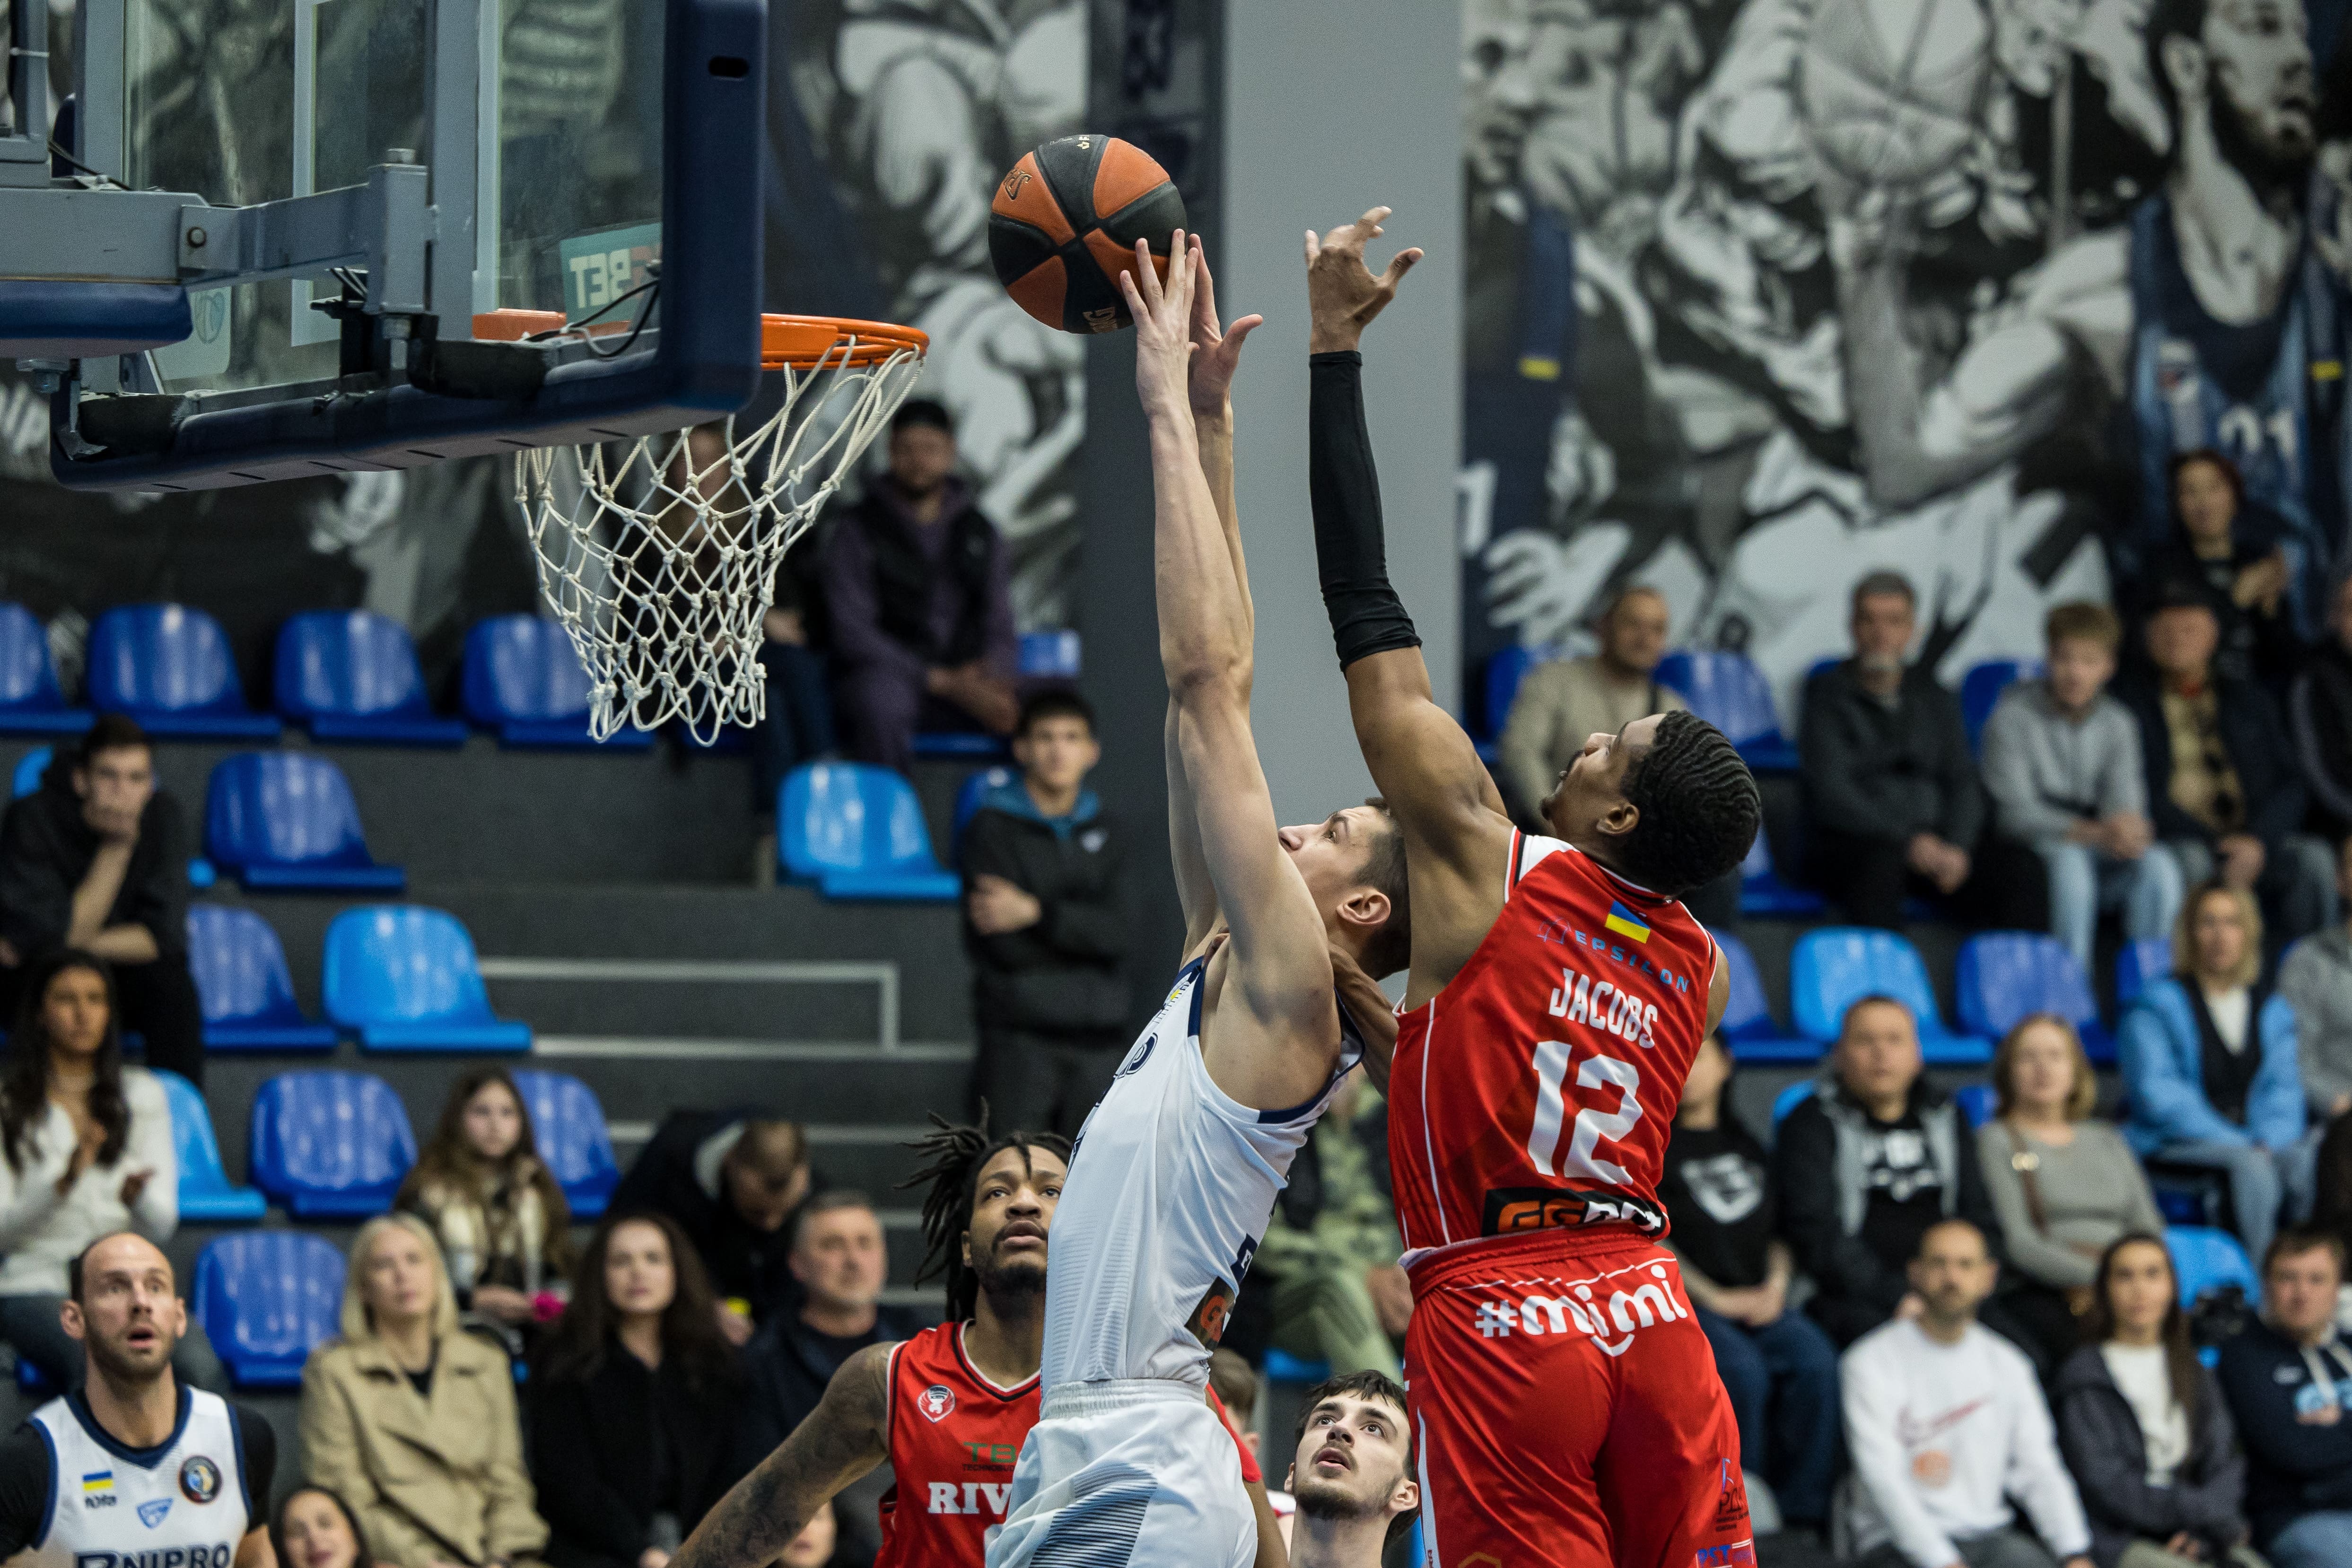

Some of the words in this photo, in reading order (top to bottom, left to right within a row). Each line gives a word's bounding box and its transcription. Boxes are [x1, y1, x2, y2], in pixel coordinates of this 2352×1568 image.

[1574, 929, 1689, 993] EPSILON
[1549, 968, 1658, 1049] JACOBS
[1527, 1040, 1643, 1185] 12
[963, 1441, 1017, 1463] TB
